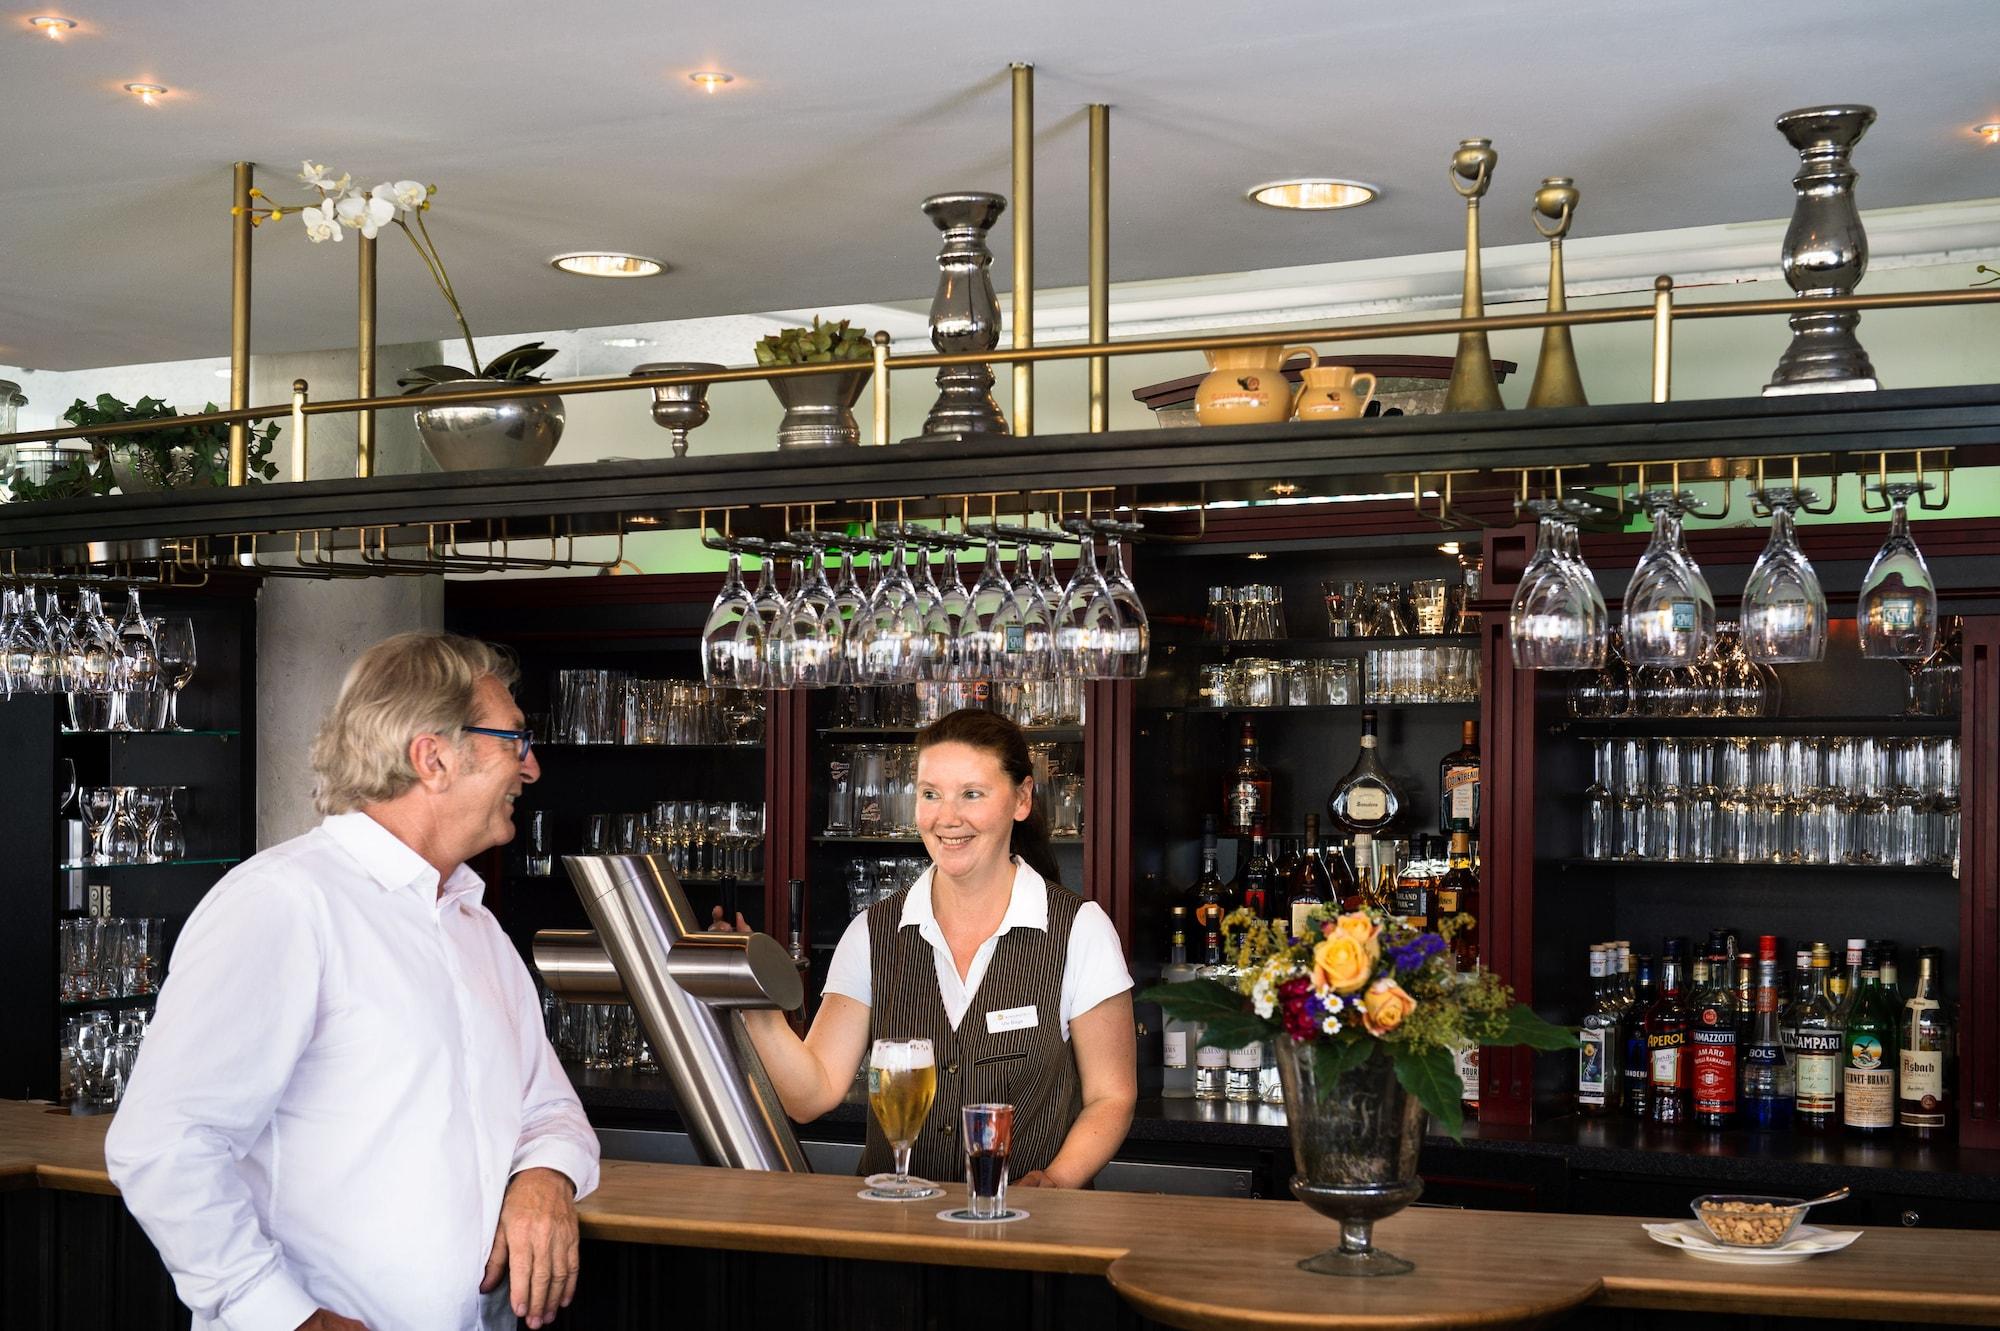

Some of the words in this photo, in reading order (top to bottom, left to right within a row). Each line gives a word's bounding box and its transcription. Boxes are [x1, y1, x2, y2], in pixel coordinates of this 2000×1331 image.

[1648, 1033, 1685, 1047] APEROL
[1694, 1033, 1735, 1043] AMAZZOTTI
[1698, 1048, 1725, 1058] AMARO
[1749, 1048, 1777, 1059] BOLS
[1904, 1059, 1935, 1073] Asbach
[1462, 1067, 1478, 1076] BOUR
